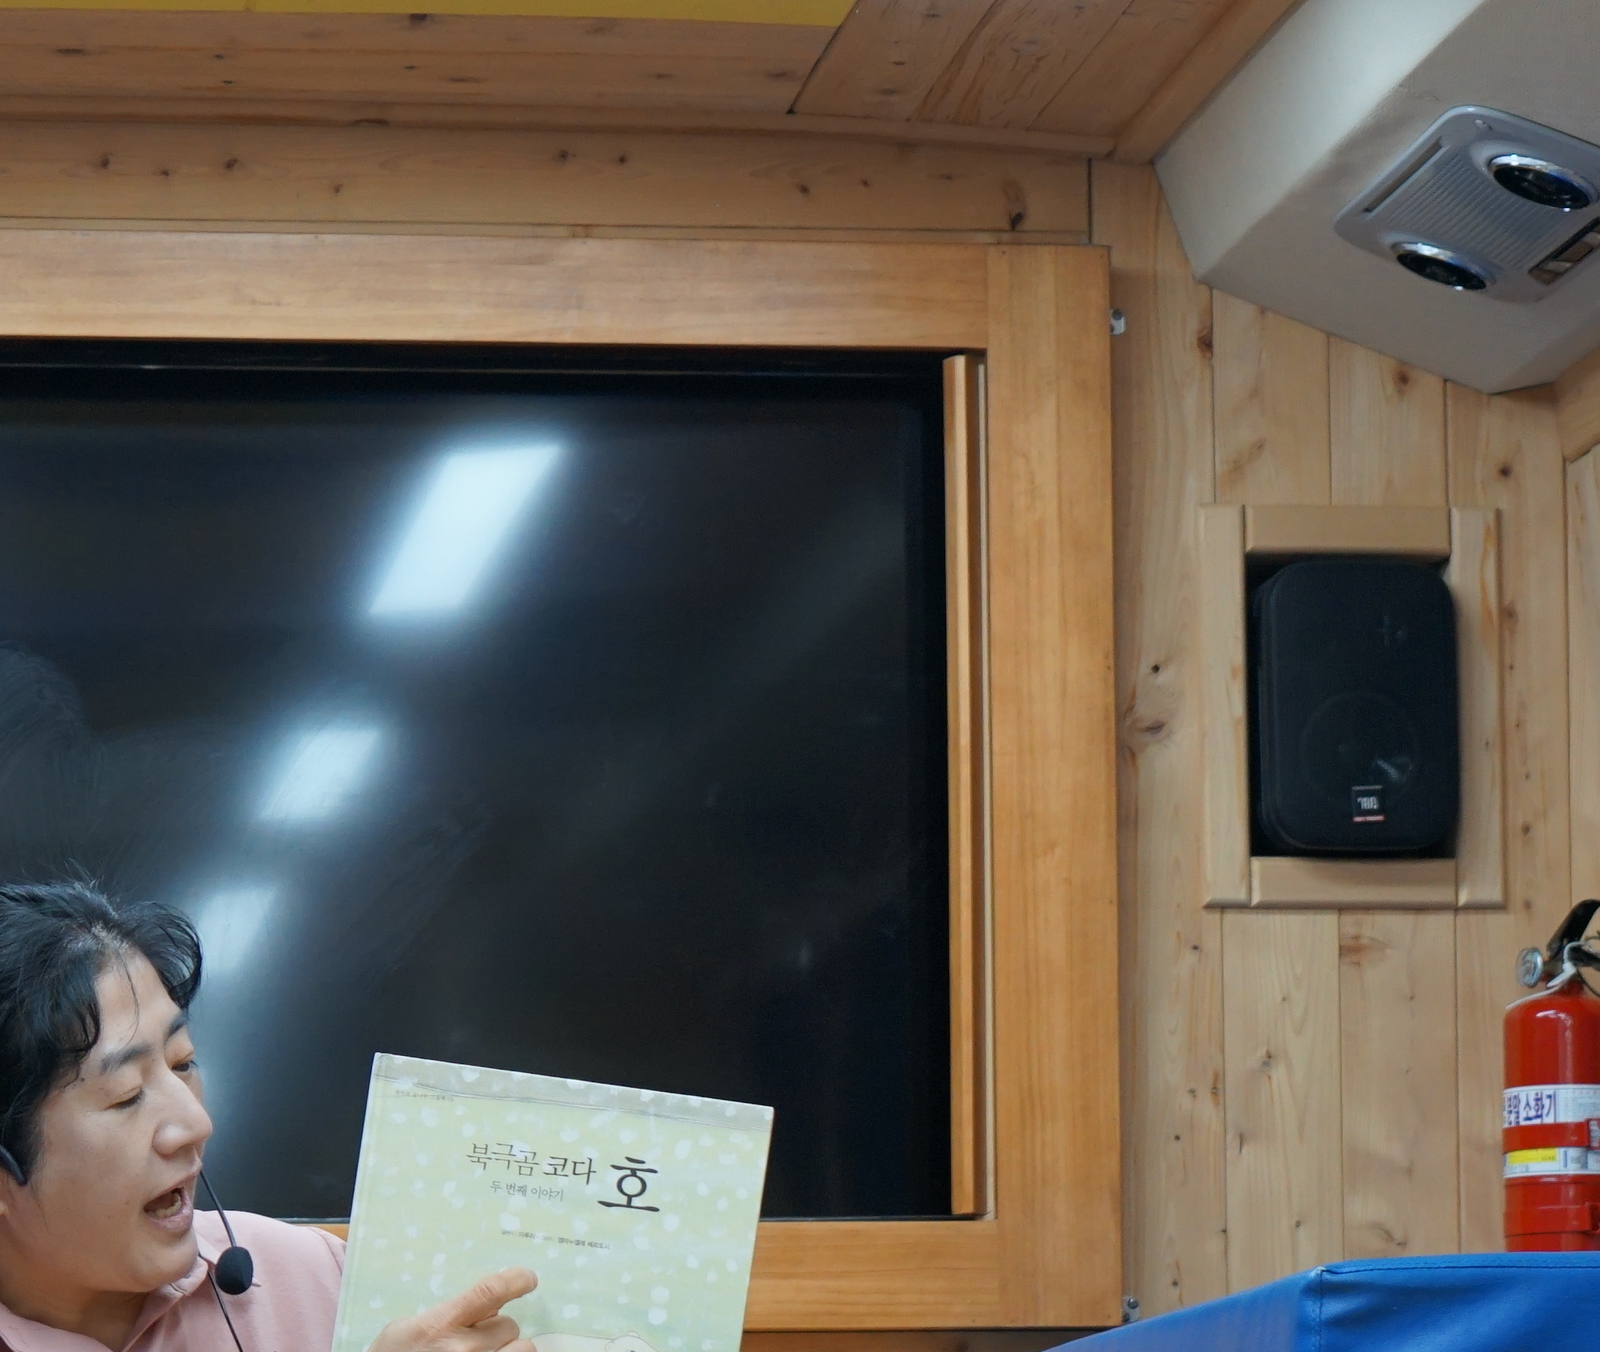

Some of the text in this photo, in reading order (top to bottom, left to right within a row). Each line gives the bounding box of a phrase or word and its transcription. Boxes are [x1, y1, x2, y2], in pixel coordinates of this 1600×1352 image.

[466, 1142, 660, 1213] 북극곰 코다 호
[490, 1180, 564, 1202] 두 번째 이야기
